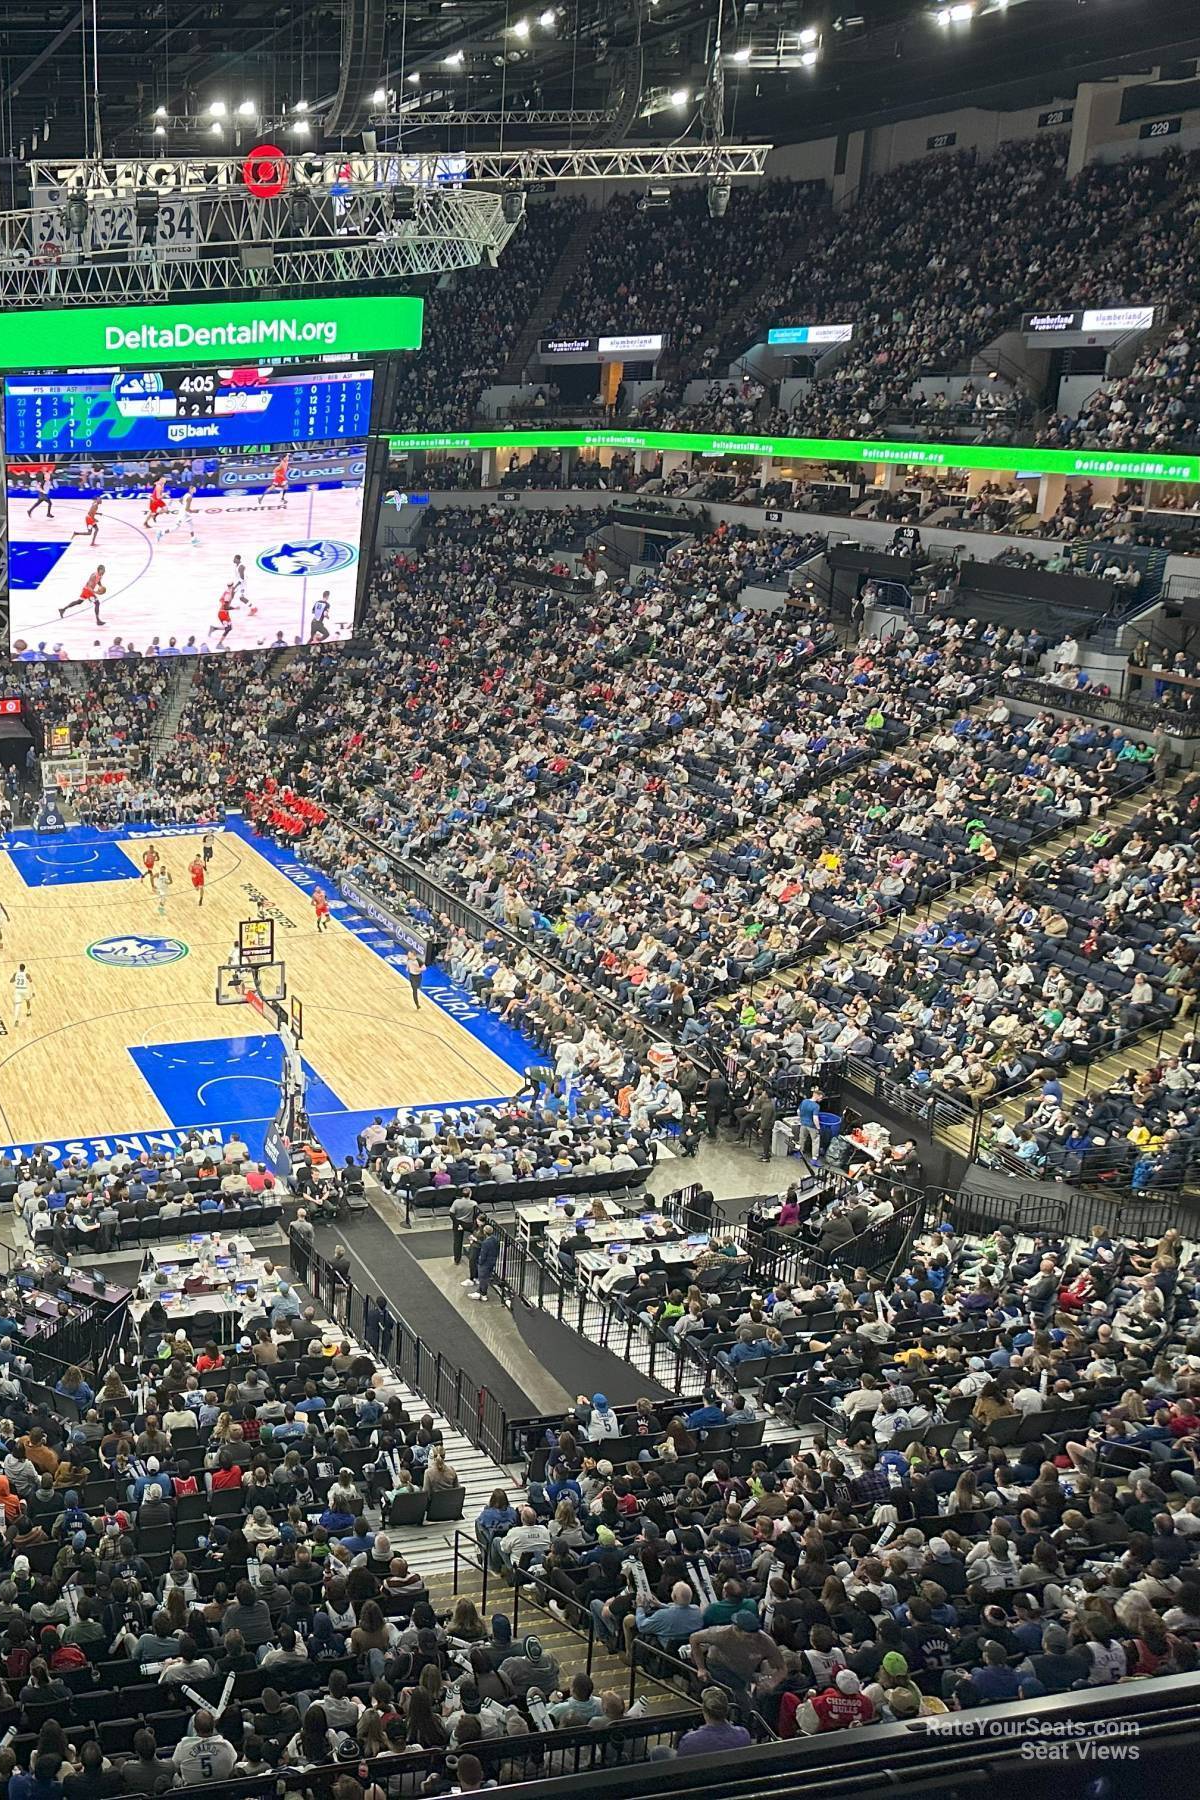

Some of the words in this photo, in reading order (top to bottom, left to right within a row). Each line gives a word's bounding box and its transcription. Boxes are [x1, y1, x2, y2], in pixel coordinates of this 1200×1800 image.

[1150, 122, 1169, 136] 229
[57, 162, 230, 200] TARGET
[159, 206, 194, 240] 34
[1030, 314, 1075, 326] slumberland
[104, 319, 338, 350] DeltaDentalMN.org
[547, 340, 590, 348] slumberland
[179, 375, 214, 393] 4:05
[179, 406, 186, 416] 6
[191, 404, 200, 416] 2
[205, 405, 213, 414] 4
[187, 423, 220, 437] bank
[300, 467, 345, 479] LEXUS
[1075, 459, 1191, 478] DeltaDentalMN.org
[374, 911, 394, 931] LEXUS
[403, 934, 425, 955] LEXUS
[604, 1420, 612, 1433] 5
[825, 1696, 862, 1706] CHICAGO
[832, 1704, 858, 1713] BULLS
[201, 1756, 213, 1778] 5
